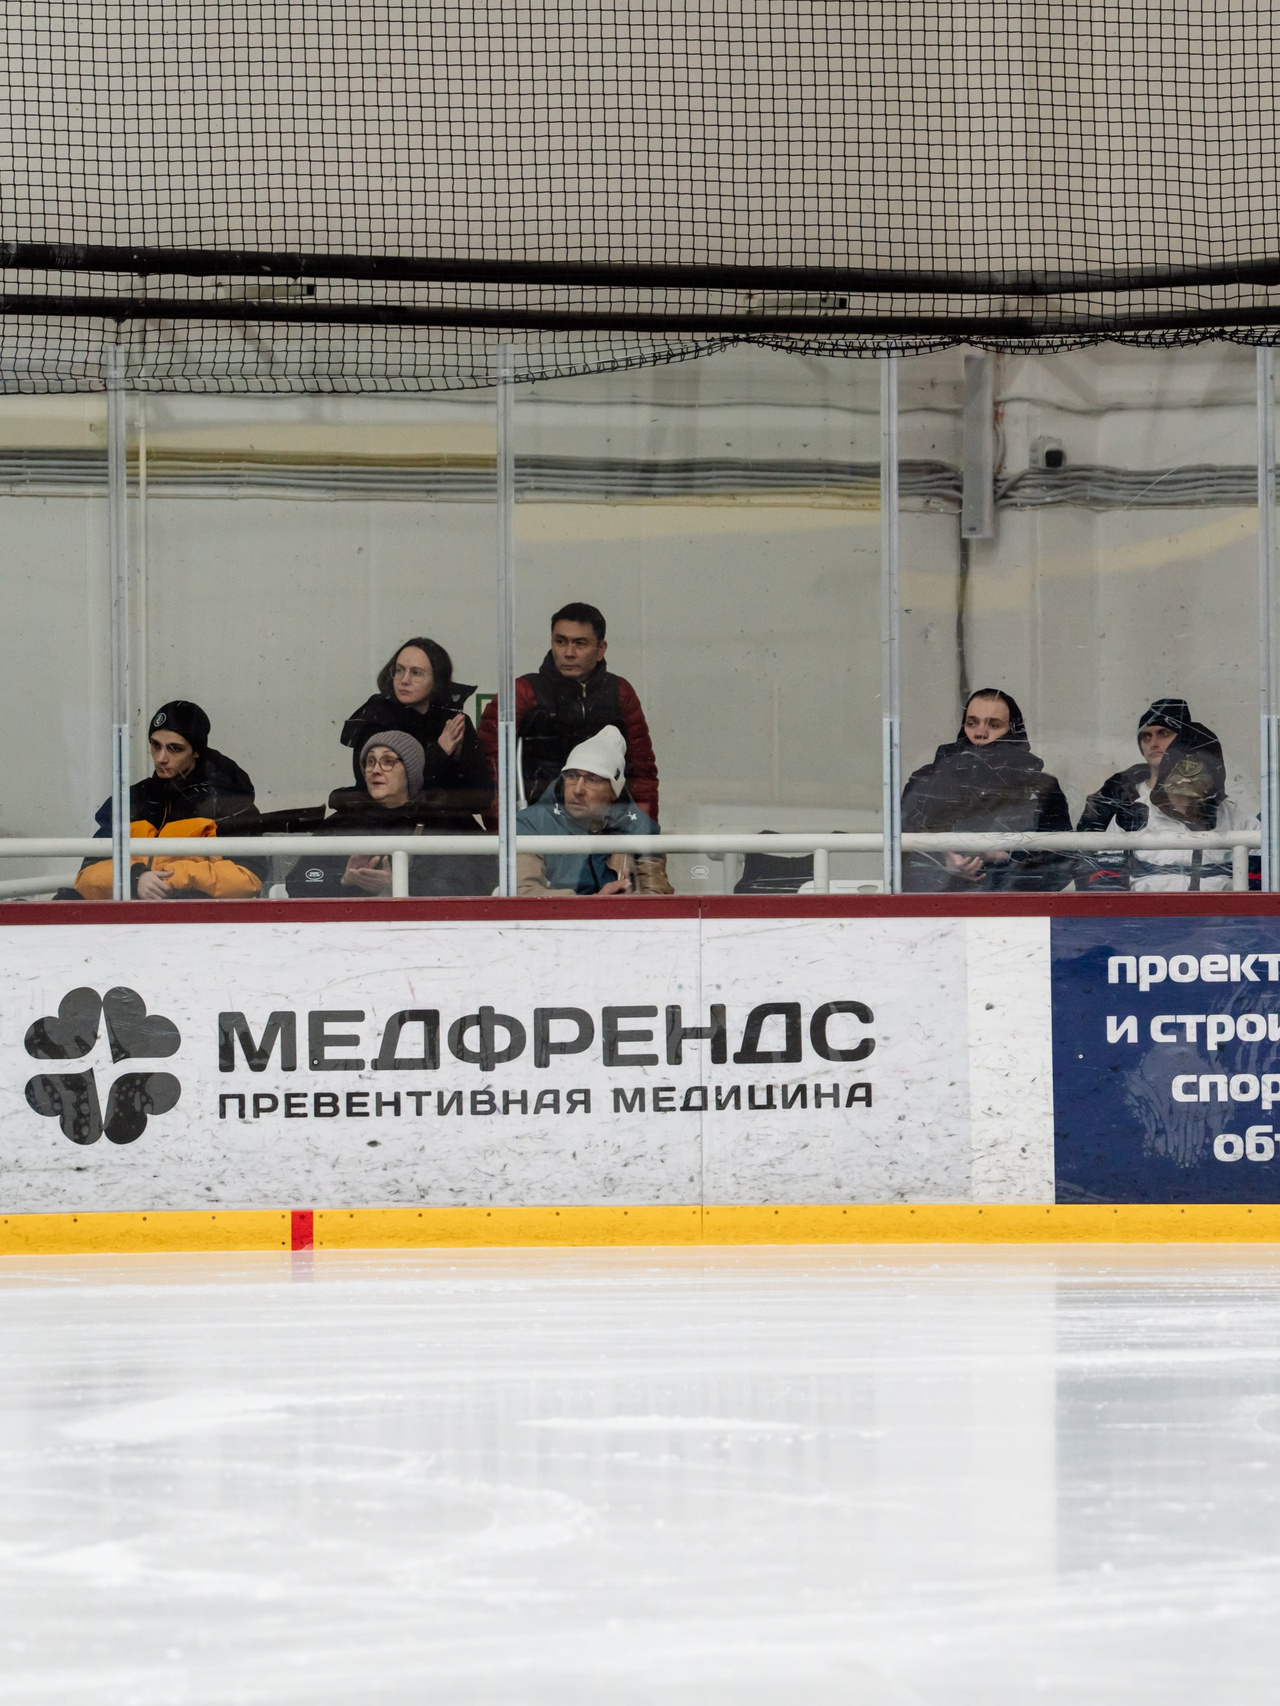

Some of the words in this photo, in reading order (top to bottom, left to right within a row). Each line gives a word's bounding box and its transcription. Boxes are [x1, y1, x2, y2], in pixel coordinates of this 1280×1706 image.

[217, 1000, 877, 1073] МЕДФРЕНДС
[1106, 1016, 1139, 1044] и
[218, 1085, 593, 1121] ПРЕВЕНТИВНАЯ
[612, 1081, 874, 1115] МЕДИЦИНА
